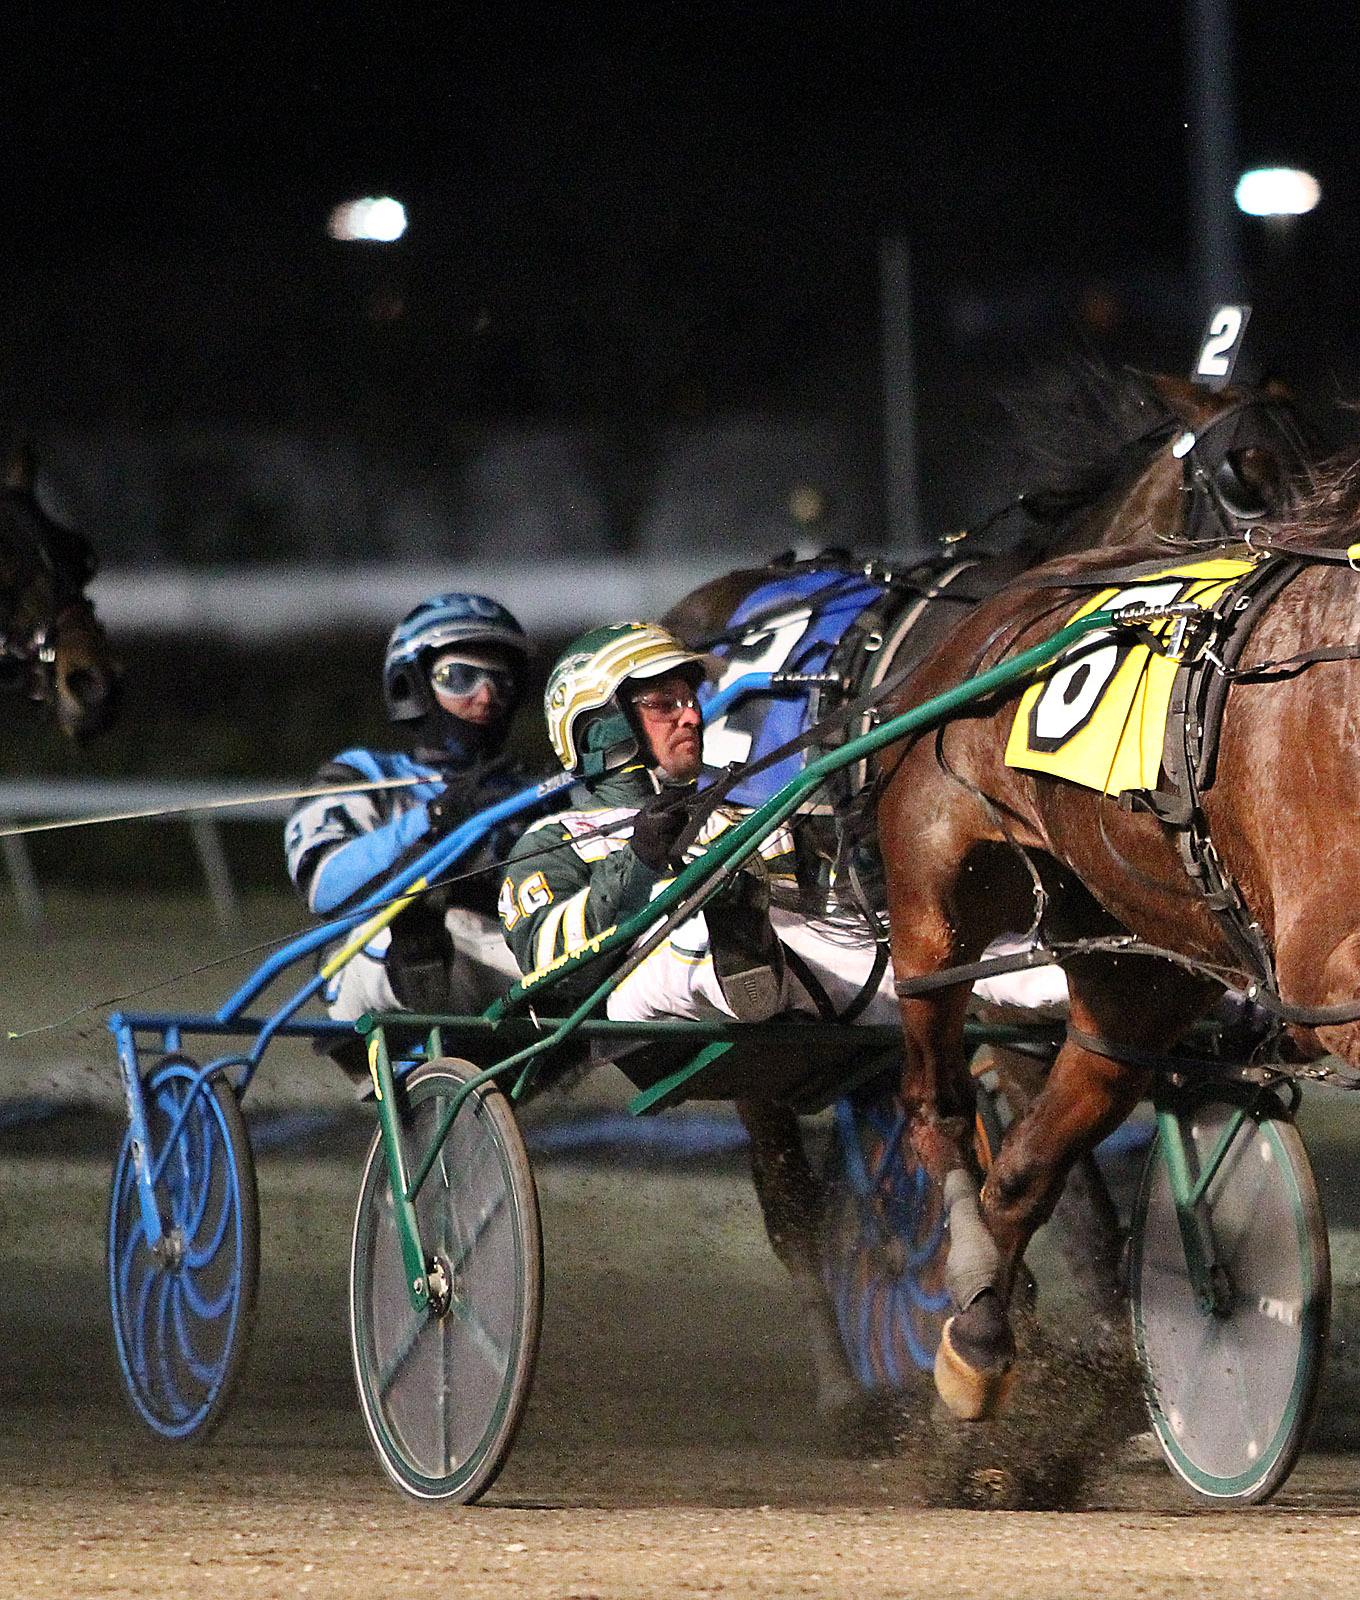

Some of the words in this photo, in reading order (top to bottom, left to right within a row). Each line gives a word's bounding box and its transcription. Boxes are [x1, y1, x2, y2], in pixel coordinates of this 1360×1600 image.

[1197, 307, 1242, 376] 2
[699, 608, 813, 769] 2
[1030, 579, 1186, 748] 6
